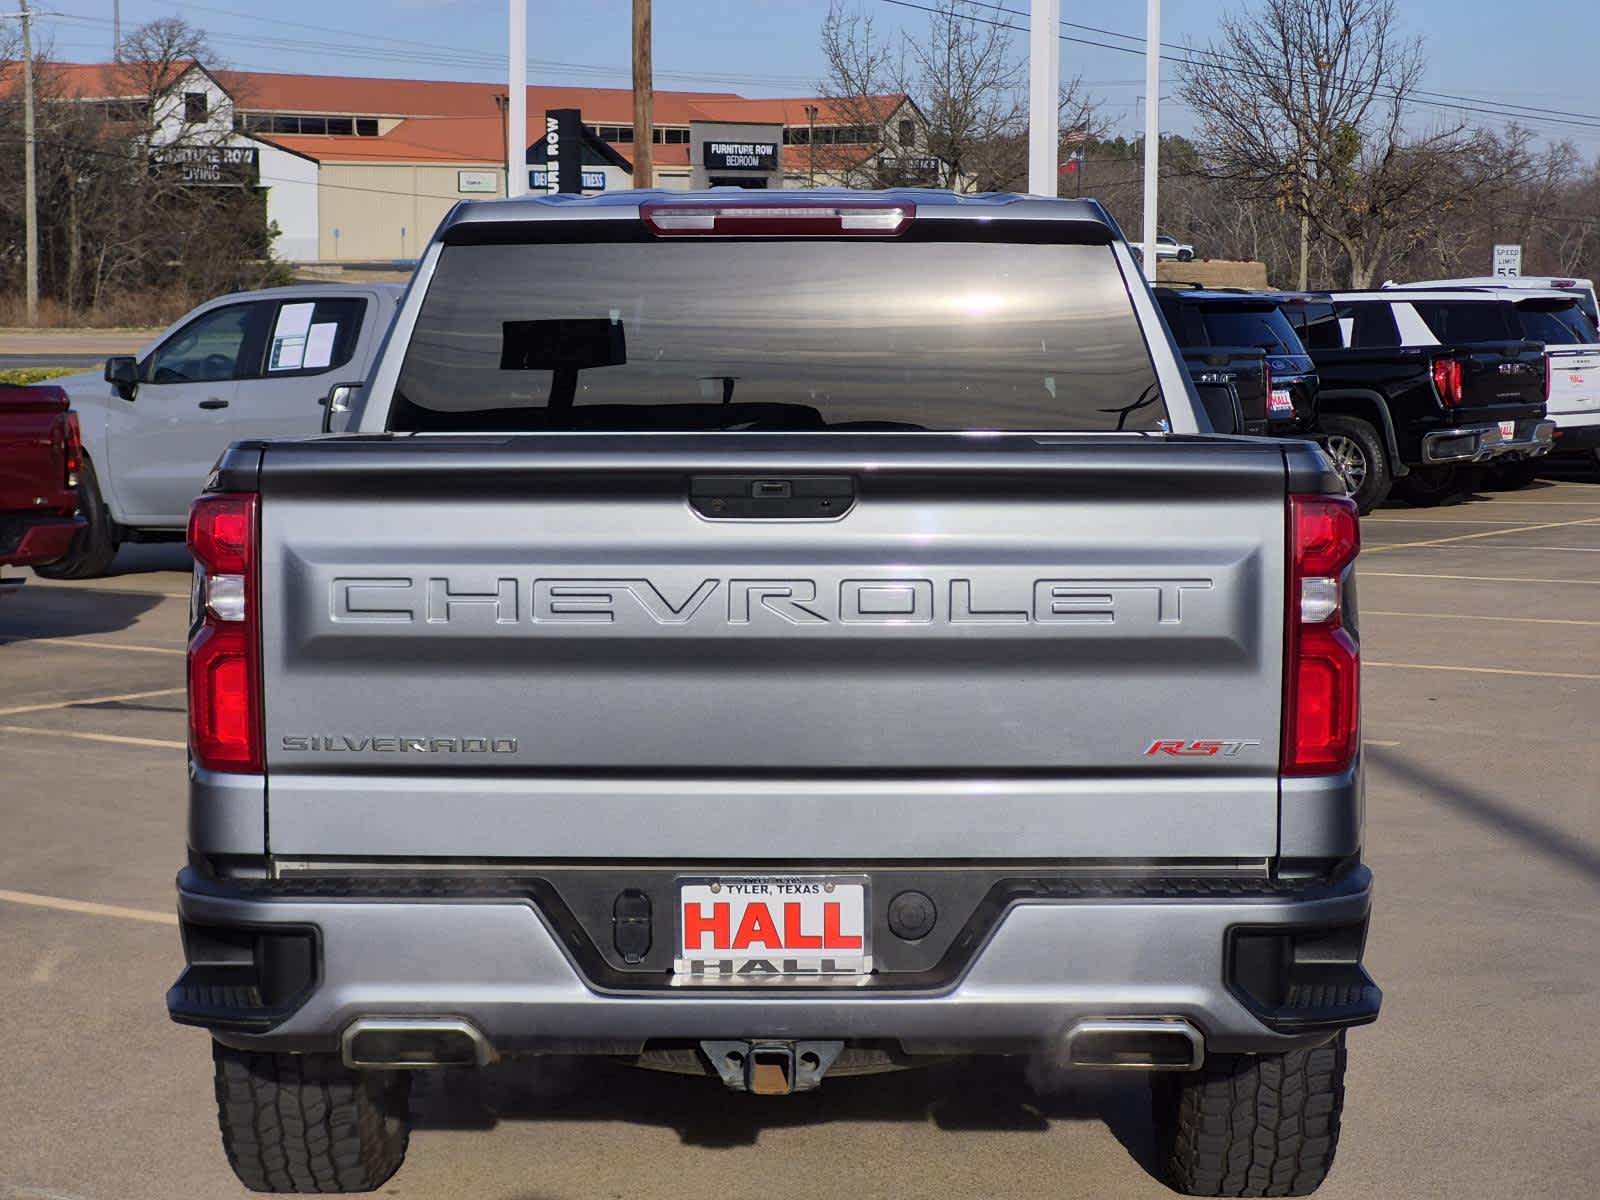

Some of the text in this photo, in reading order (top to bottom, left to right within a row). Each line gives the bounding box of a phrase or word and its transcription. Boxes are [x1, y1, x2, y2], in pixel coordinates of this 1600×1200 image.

[546, 117, 559, 155] ROW
[223, 149, 253, 163] ROW
[711, 143, 773, 155] FURNITURE ROW
[726, 155, 759, 167] BEDROOM
[1497, 267, 1518, 278] 55
[331, 576, 1213, 624] CHEVROLET
[282, 735, 518, 754] SILVERADO
[1143, 738, 1260, 757] RST
[726, 884, 820, 896] TYLER, TEXAS
[684, 902, 862, 950] HALL
